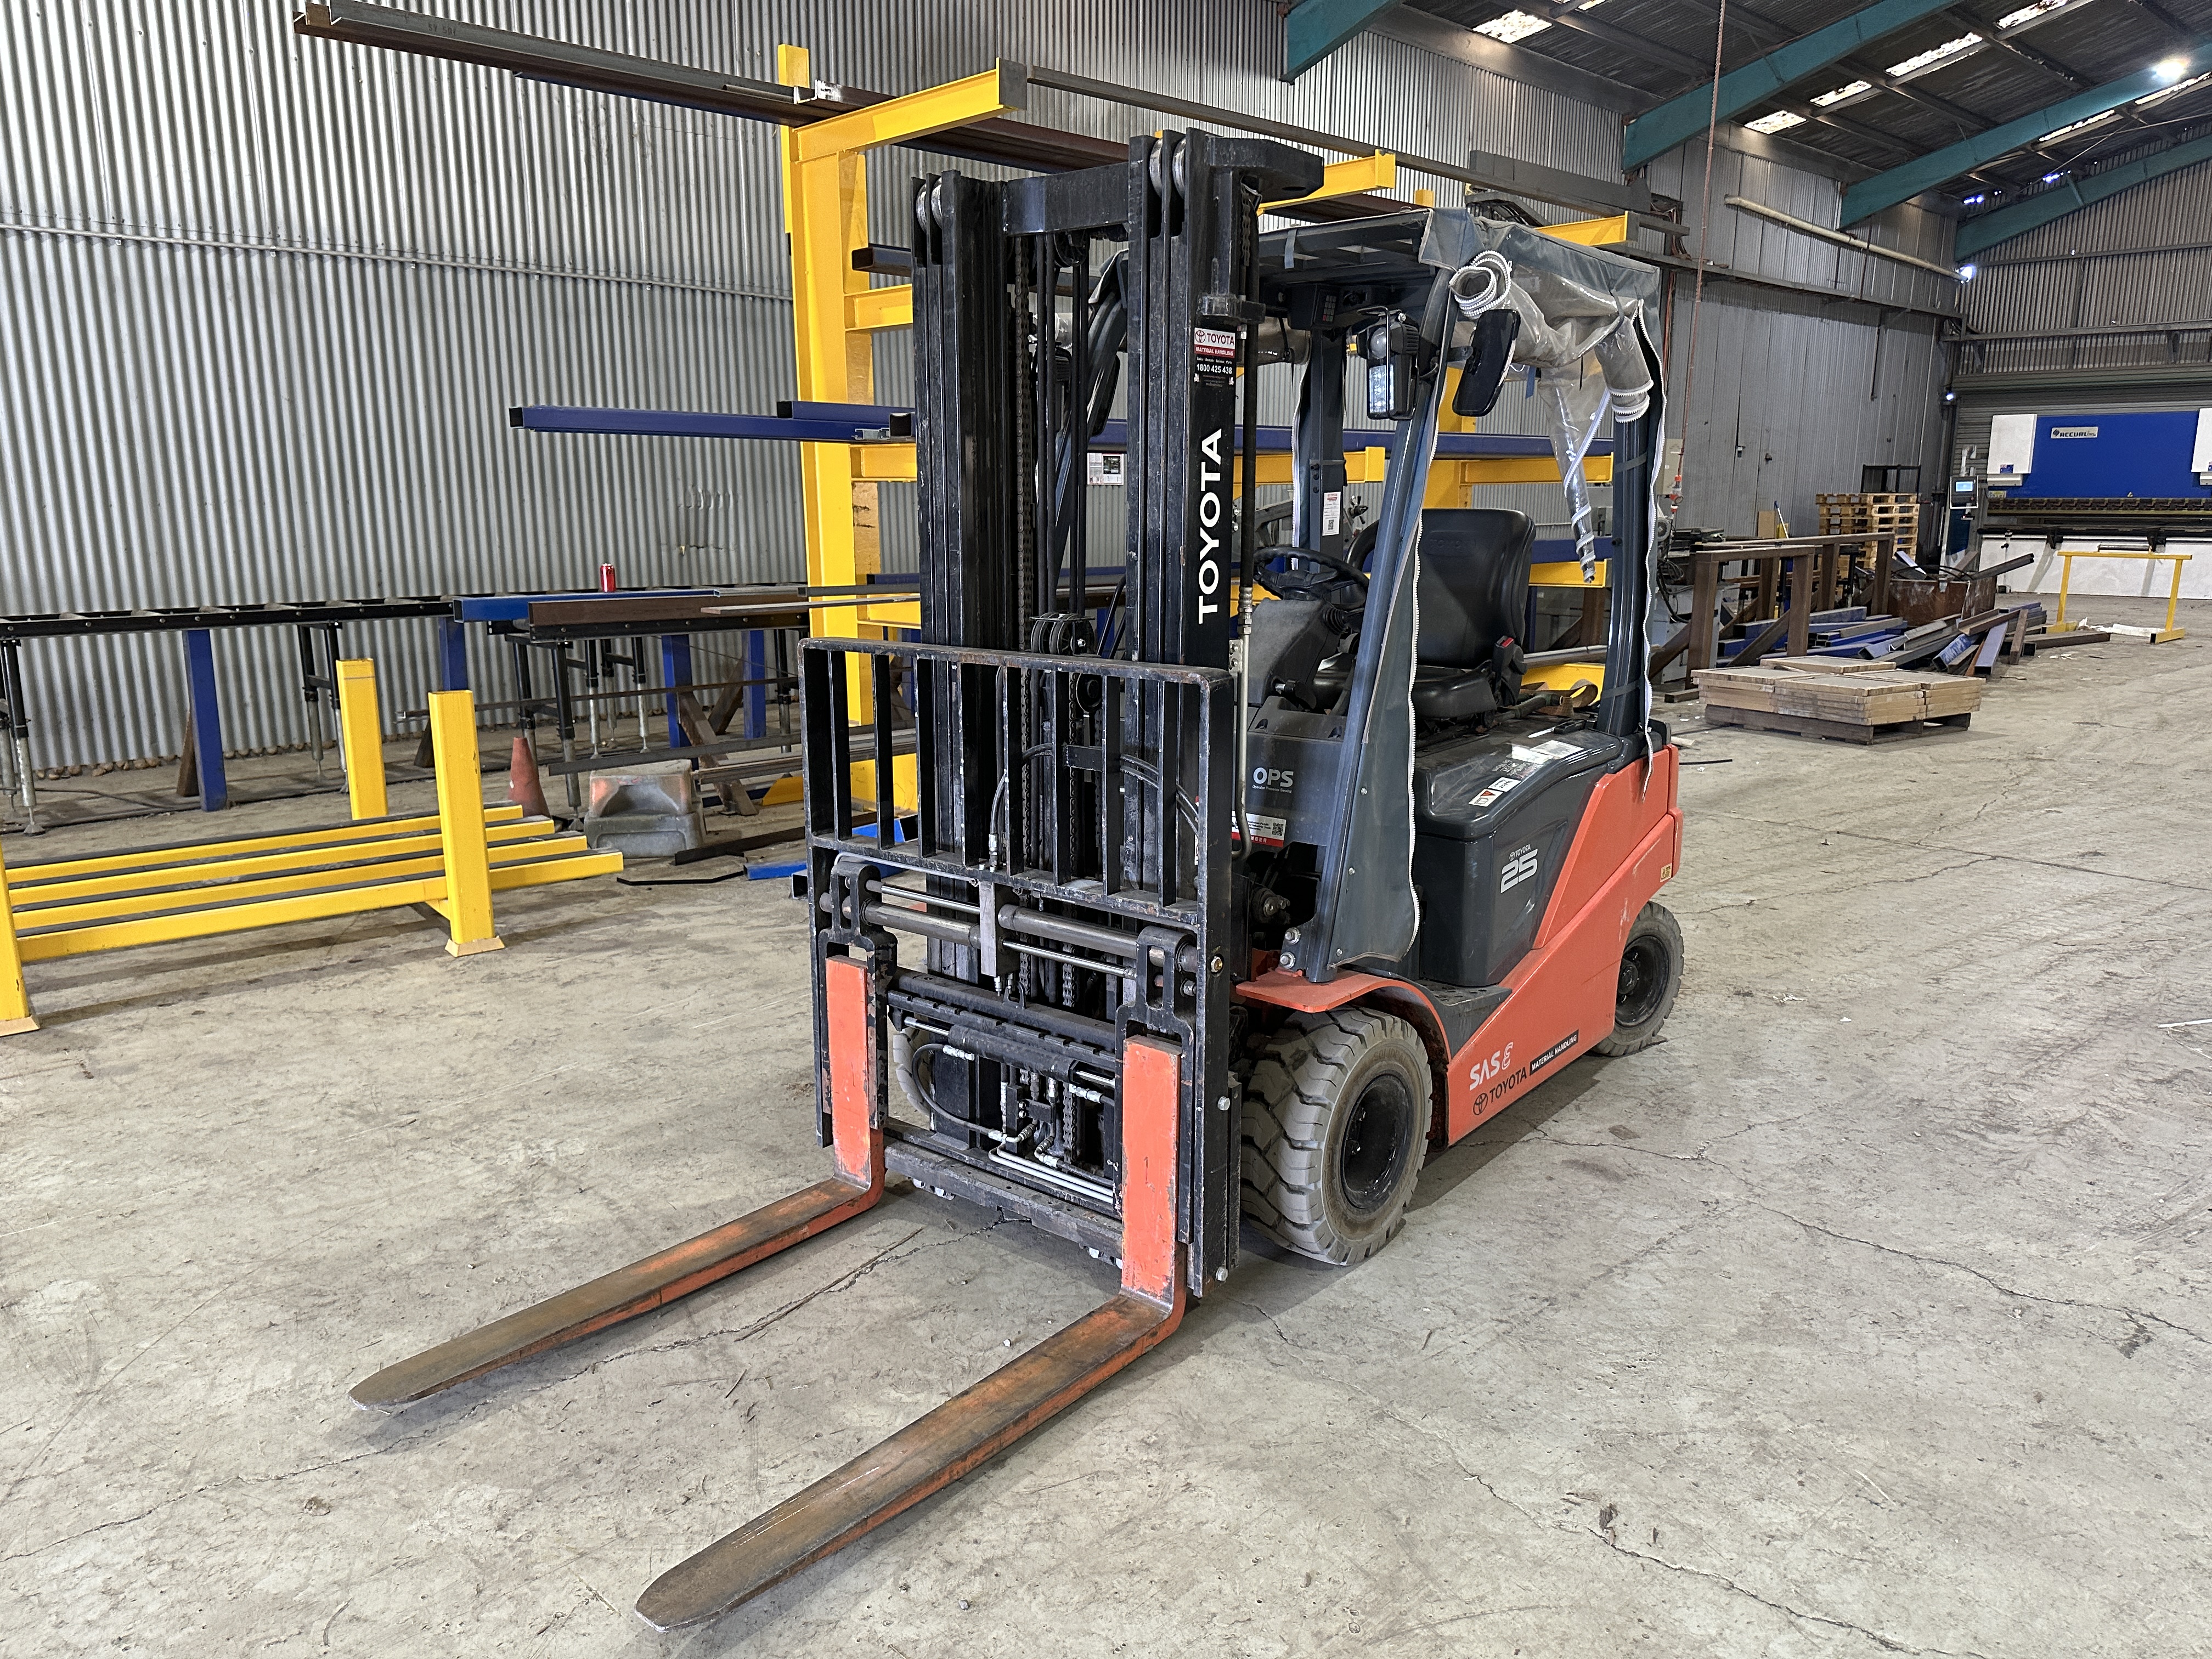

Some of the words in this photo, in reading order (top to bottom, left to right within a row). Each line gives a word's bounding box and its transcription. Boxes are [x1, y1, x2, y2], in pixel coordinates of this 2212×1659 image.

[1206, 333, 1234, 346] TOYOTA
[1197, 363, 1210, 372] 1800
[1211, 365, 1221, 373] 425
[1222, 366, 1232, 374] 438
[1198, 428, 1222, 624] TOYOTA
[1253, 767, 1294, 787] OPS
[1515, 844, 1531, 857] TOYOTA
[1500, 848, 1538, 894] 25
[1489, 1066, 1527, 1103] TOYOTA
[1531, 1050, 1554, 1071] MATERIAL
[1554, 1034, 1577, 1057] HANDLING
